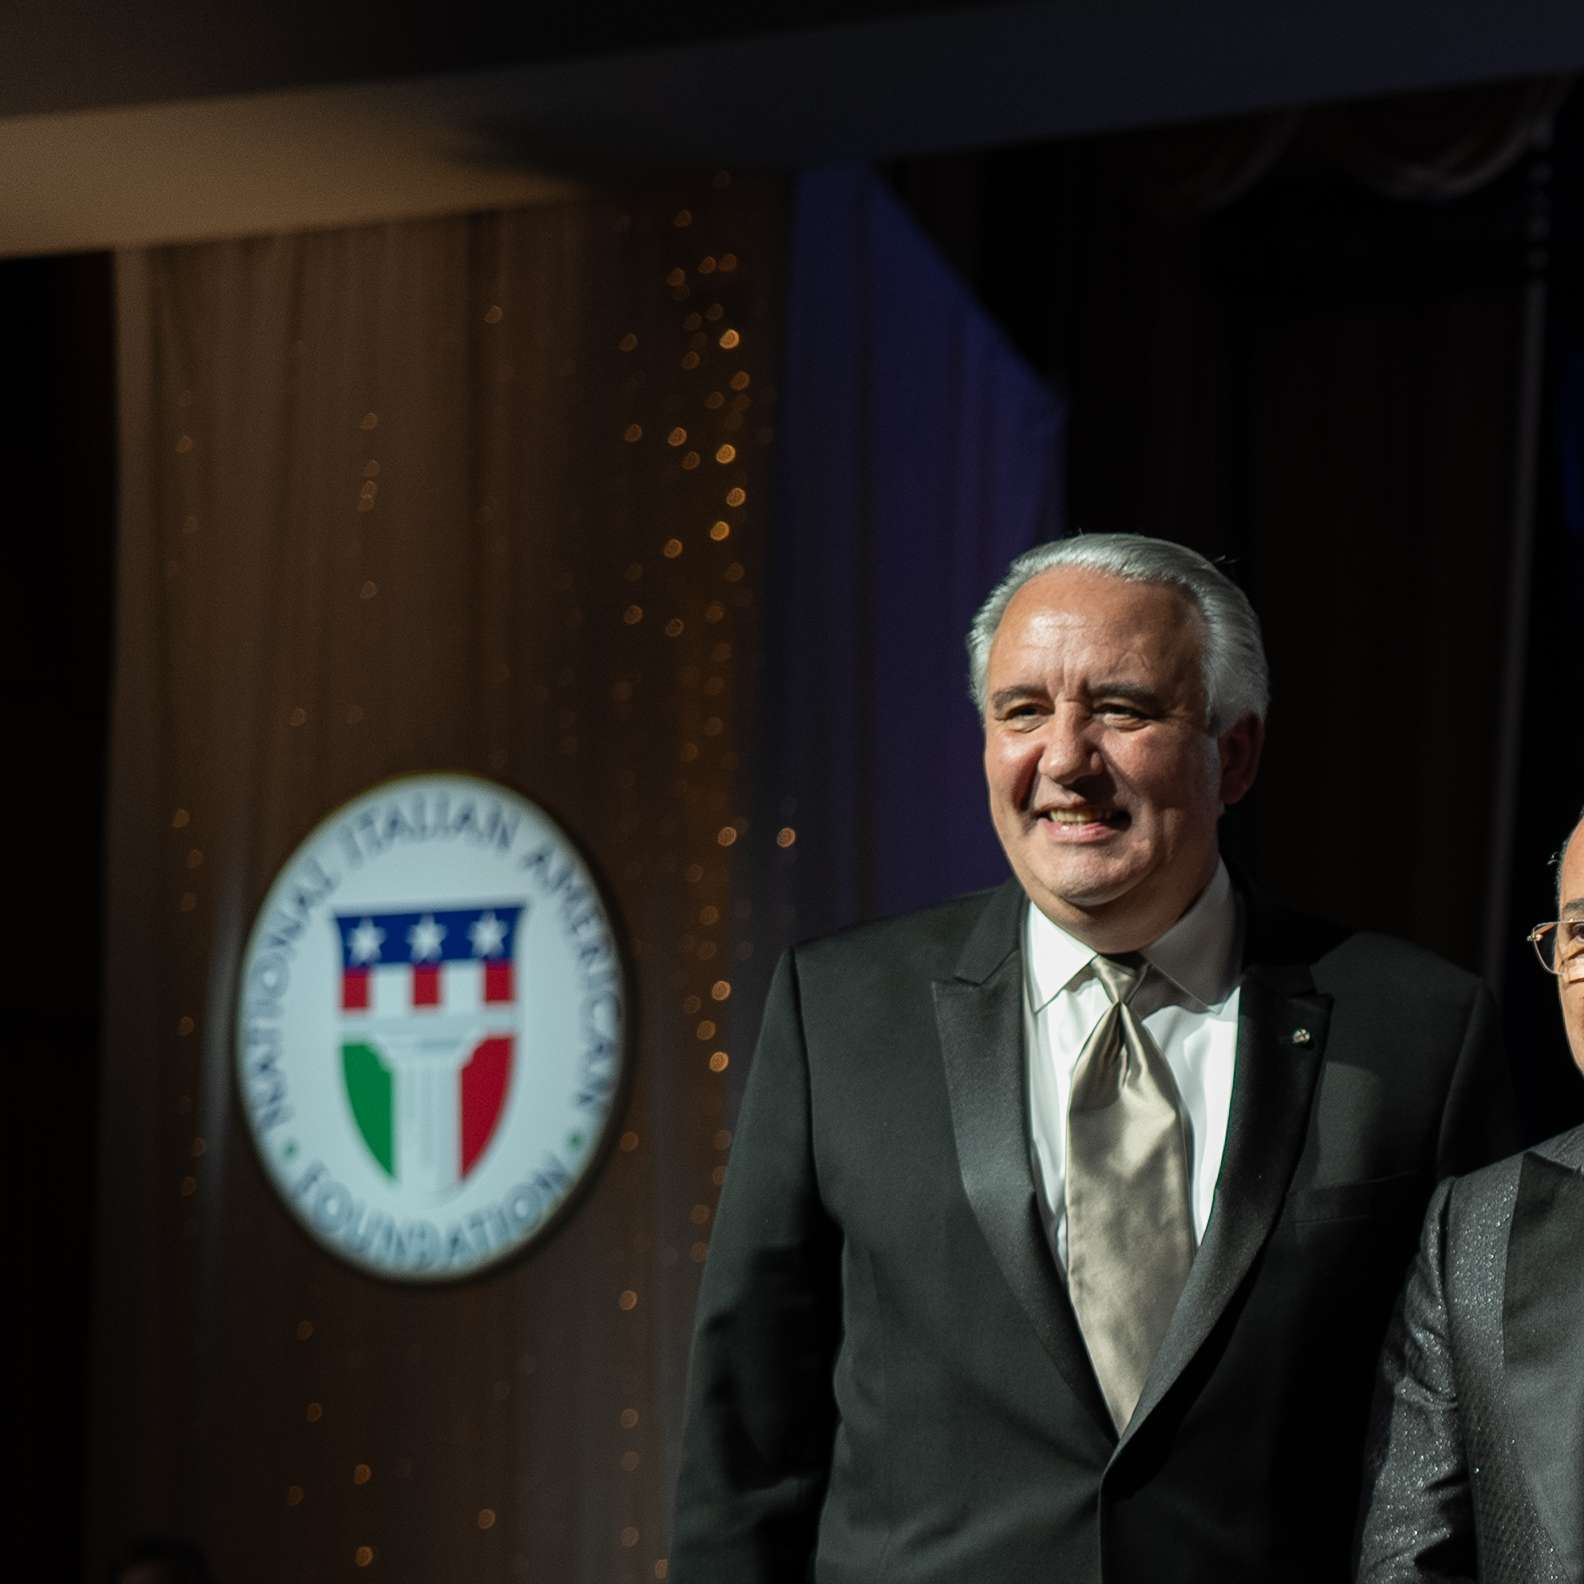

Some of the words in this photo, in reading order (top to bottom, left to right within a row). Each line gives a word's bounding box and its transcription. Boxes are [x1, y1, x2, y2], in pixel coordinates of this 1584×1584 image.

[245, 857, 338, 1131] NATIONAL
[337, 793, 519, 868] ITALIAN
[524, 844, 618, 1108] AMERICAN
[302, 1153, 570, 1272] FOUNDATION
